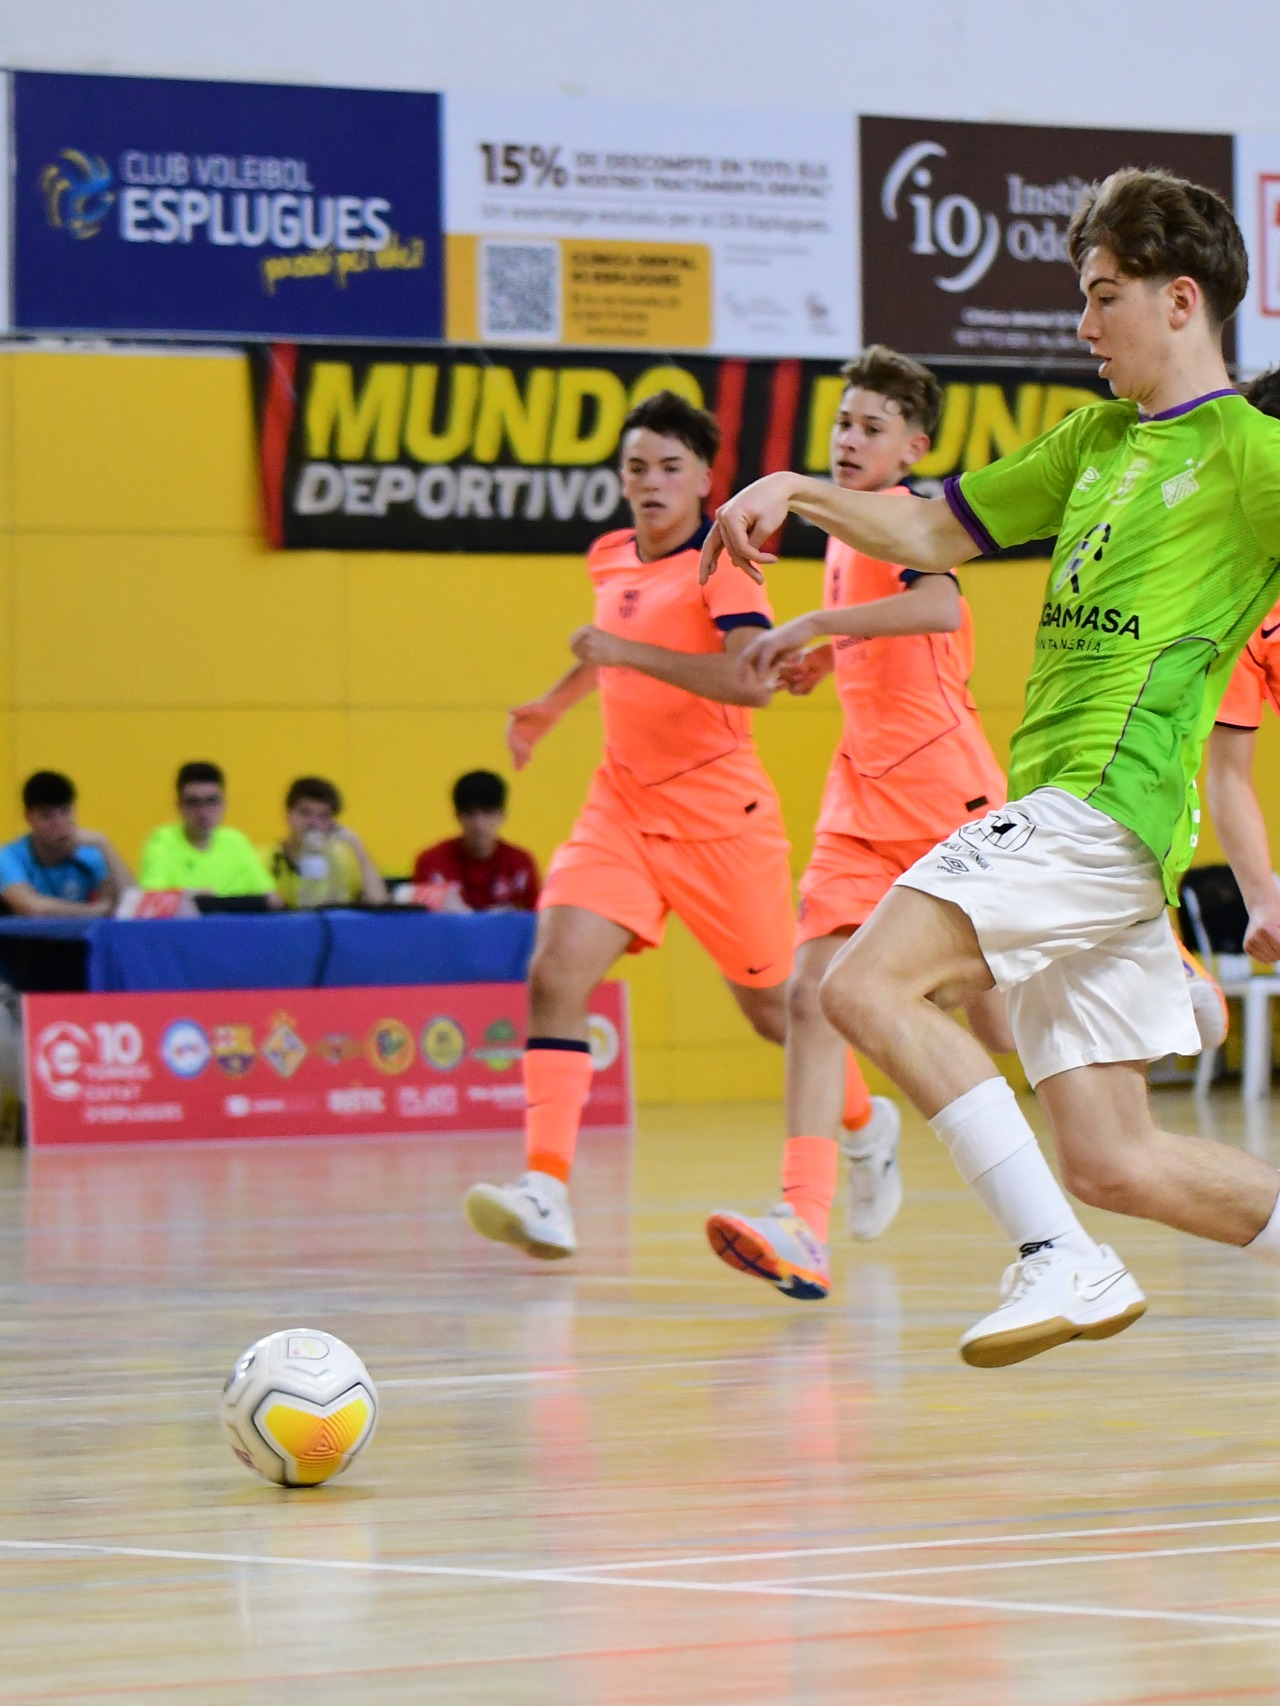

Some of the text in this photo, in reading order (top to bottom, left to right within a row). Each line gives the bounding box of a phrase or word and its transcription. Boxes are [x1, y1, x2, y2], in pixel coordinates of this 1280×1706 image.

[121, 150, 313, 191] CLUB VOLEIBOL
[479, 142, 567, 188] 15%
[118, 187, 392, 252] ESPLUGUES
[296, 461, 622, 522] DEPORTIVO
[1039, 601, 1140, 641] GAMASA
[93, 1020, 144, 1066] 10
